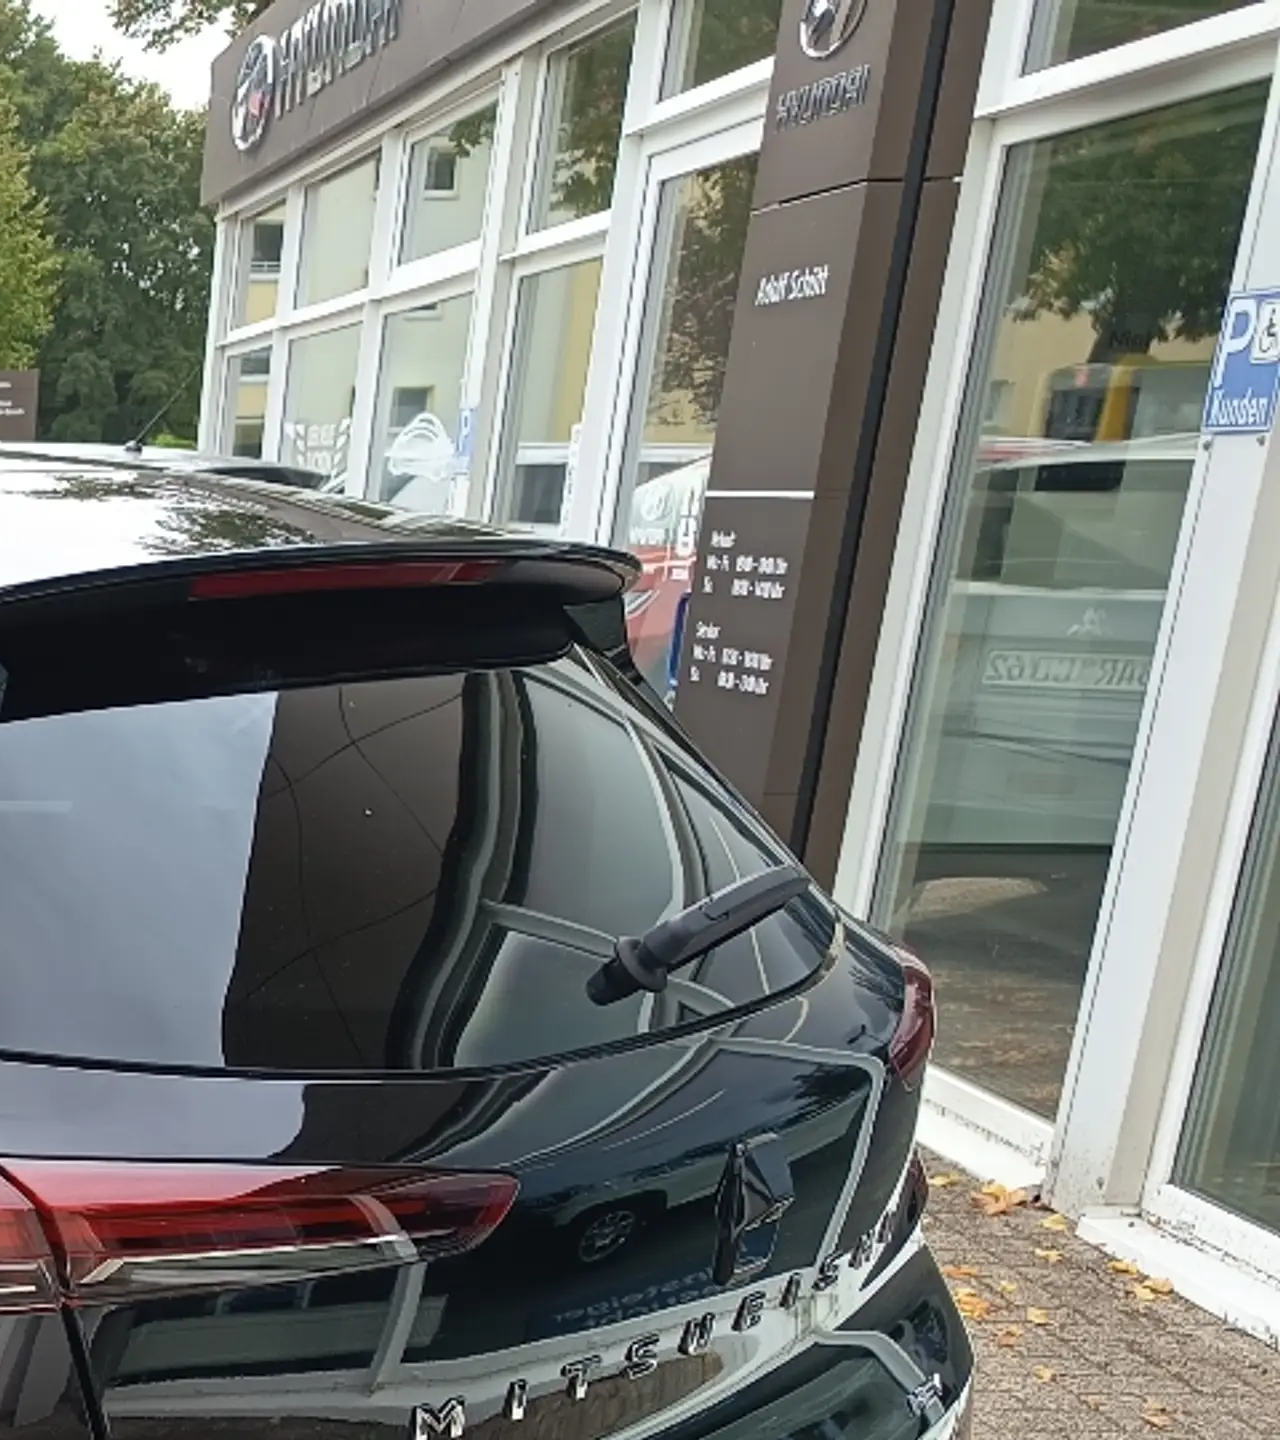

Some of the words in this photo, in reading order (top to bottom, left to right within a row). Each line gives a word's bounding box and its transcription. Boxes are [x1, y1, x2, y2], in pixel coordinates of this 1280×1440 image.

[274, 0, 400, 122] HYUNDAI
[1213, 299, 1257, 388] P
[1208, 387, 1269, 426] Kunden
